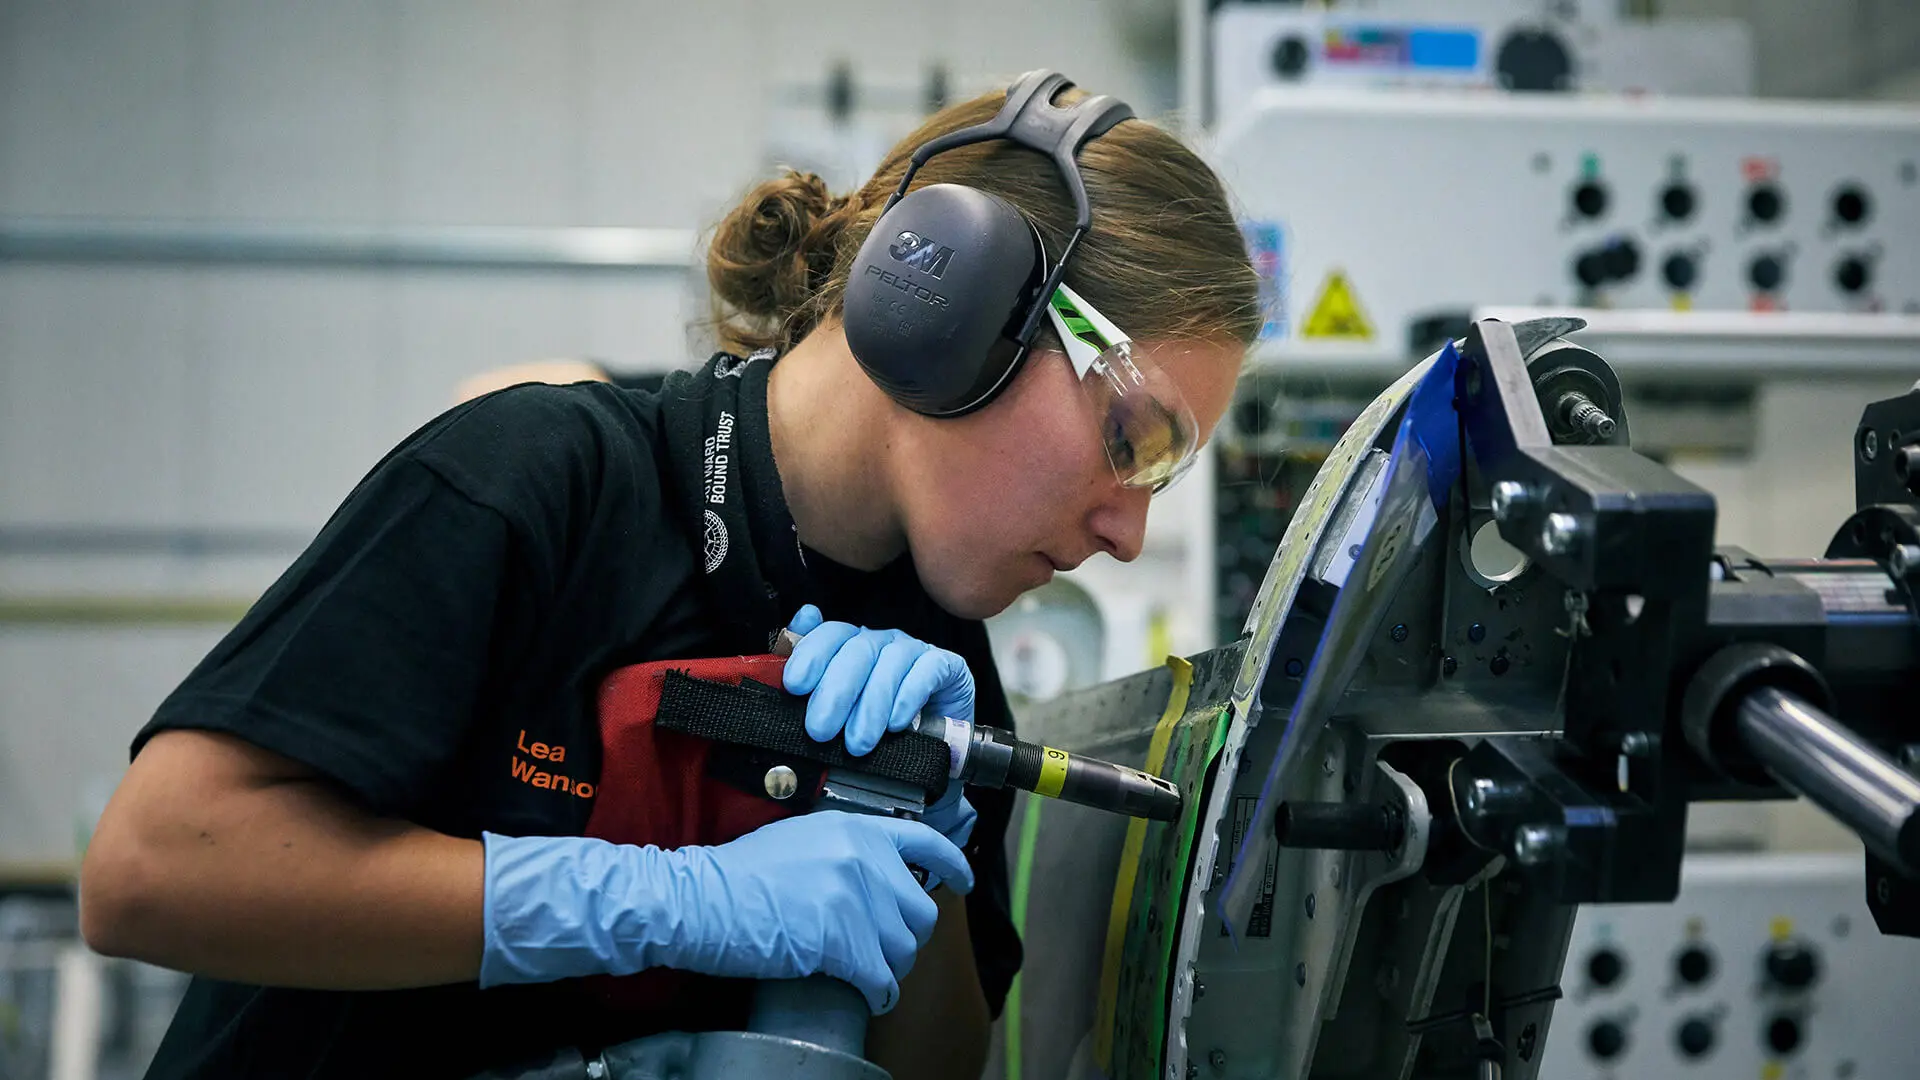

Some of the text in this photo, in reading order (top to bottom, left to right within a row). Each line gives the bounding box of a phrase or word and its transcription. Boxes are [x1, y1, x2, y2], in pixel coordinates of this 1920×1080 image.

[889, 231, 956, 281] 3M
[864, 264, 950, 312] PELTOR
[710, 411, 736, 505] BOUND TRUST
[517, 728, 566, 762] Lea
